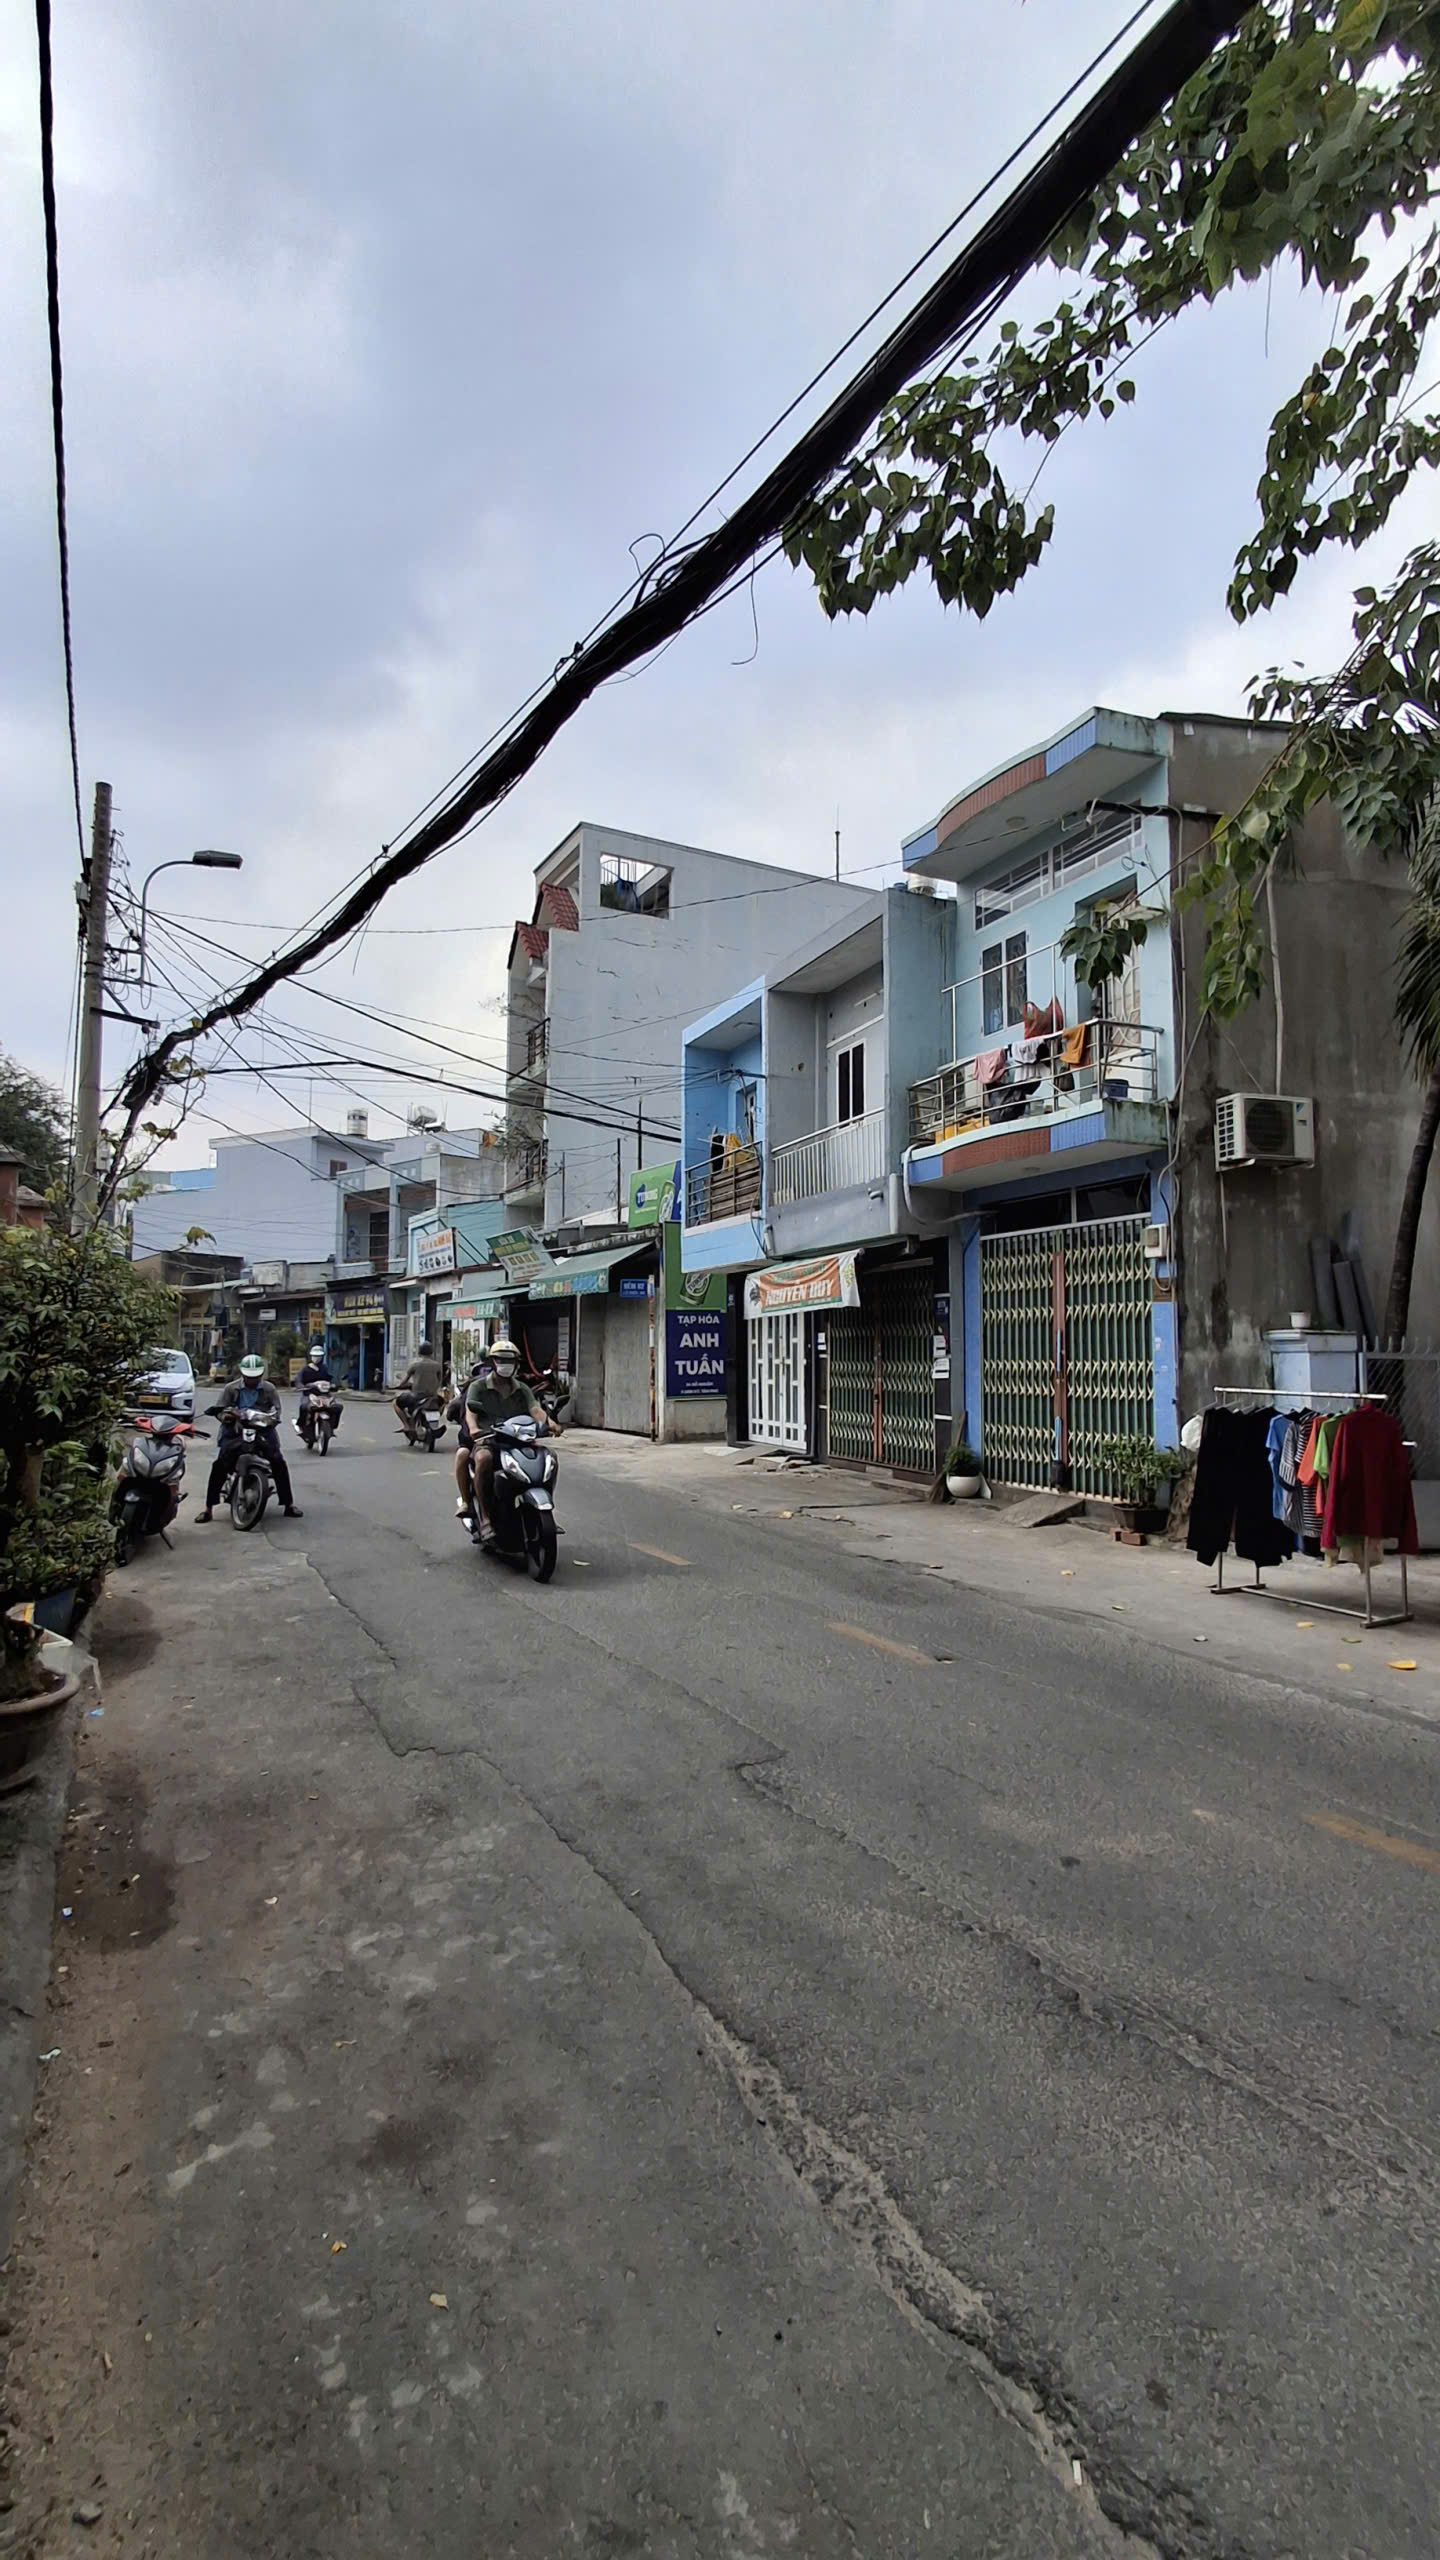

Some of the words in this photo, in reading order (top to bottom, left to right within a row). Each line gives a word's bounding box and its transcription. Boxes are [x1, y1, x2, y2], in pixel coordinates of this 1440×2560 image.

[677, 1315, 697, 1327] TẠP
[698, 1313, 720, 1324] HÓA
[679, 1332, 720, 1348] ANH
[674, 1353, 725, 1376] TUẤN
